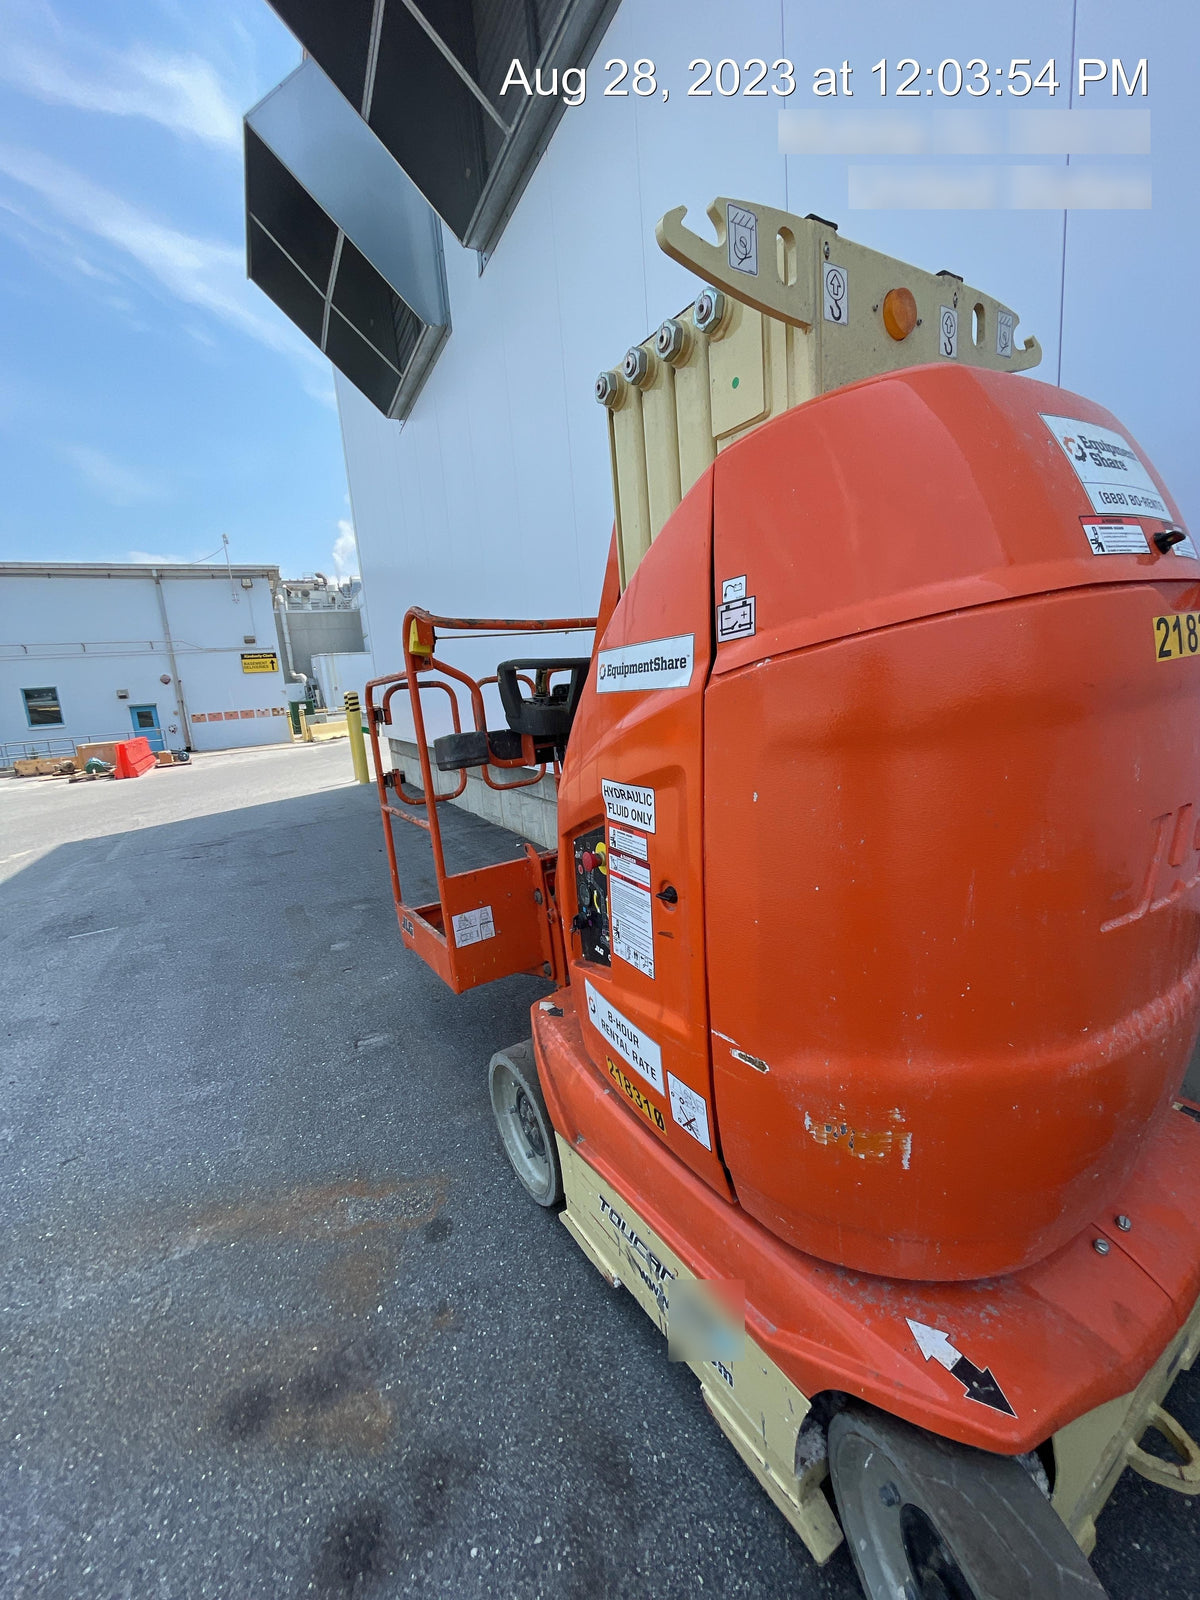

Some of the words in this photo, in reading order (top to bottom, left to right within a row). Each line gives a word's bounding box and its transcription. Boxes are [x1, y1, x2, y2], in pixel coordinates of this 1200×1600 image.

[1089, 452, 1128, 471] Share
[1098, 491, 1129, 506] (888)
[1156, 613, 1200, 658] 218
[606, 655, 687, 679] EquipmentShare
[603, 784, 653, 807] HYDRAULIC
[607, 802, 629, 819] FLUID
[630, 808, 653, 826] ONLY
[607, 1010, 640, 1049] 8-HOUR
[600, 1019, 630, 1057] RENTAL
[631, 1050, 657, 1082] RATE
